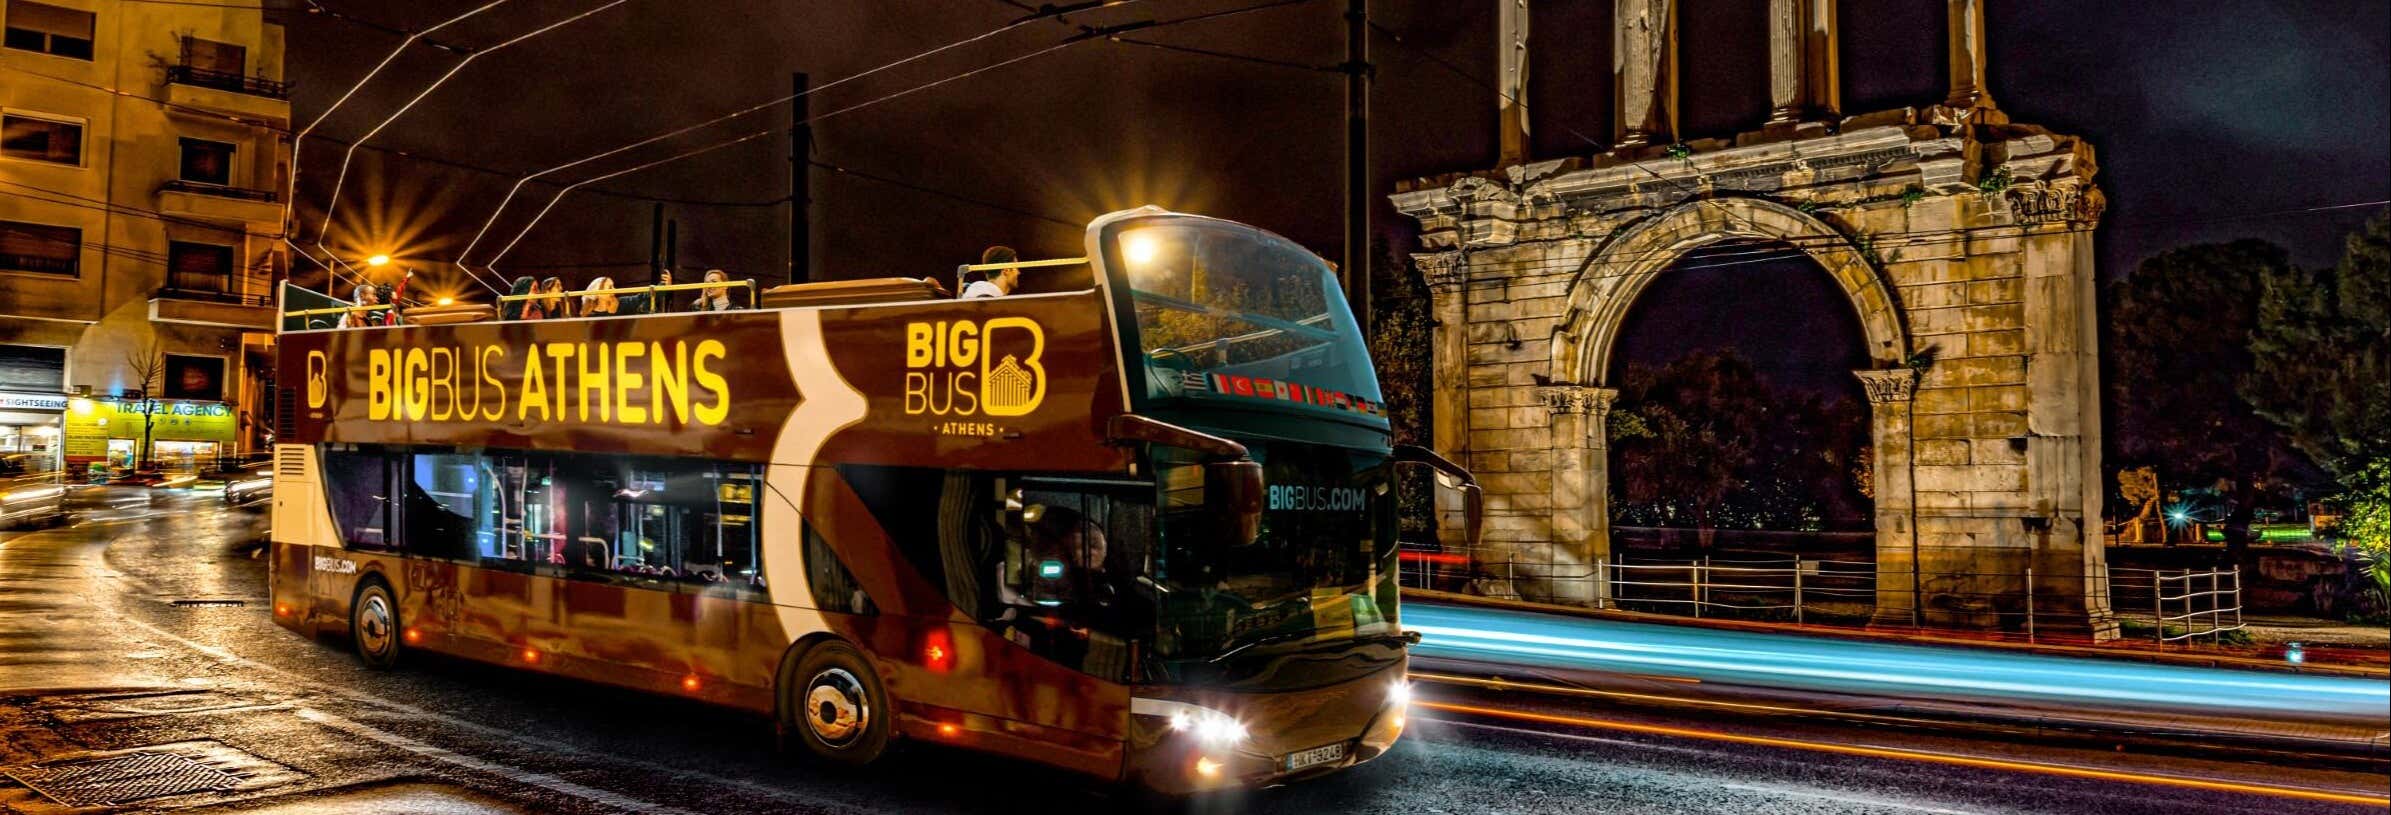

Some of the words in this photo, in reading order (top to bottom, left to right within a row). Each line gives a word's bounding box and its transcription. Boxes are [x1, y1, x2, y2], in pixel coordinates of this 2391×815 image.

[907, 320, 979, 368] BIG
[369, 345, 506, 421] BIGBUS
[518, 339, 730, 426] ATHENS
[905, 371, 978, 416] BUS
[6, 398, 68, 408] SIGHTSEEING
[172, 404, 231, 416] AGENCY
[942, 422, 995, 436] ATHENS
[1269, 485, 1366, 511] BIGBUS.COM
